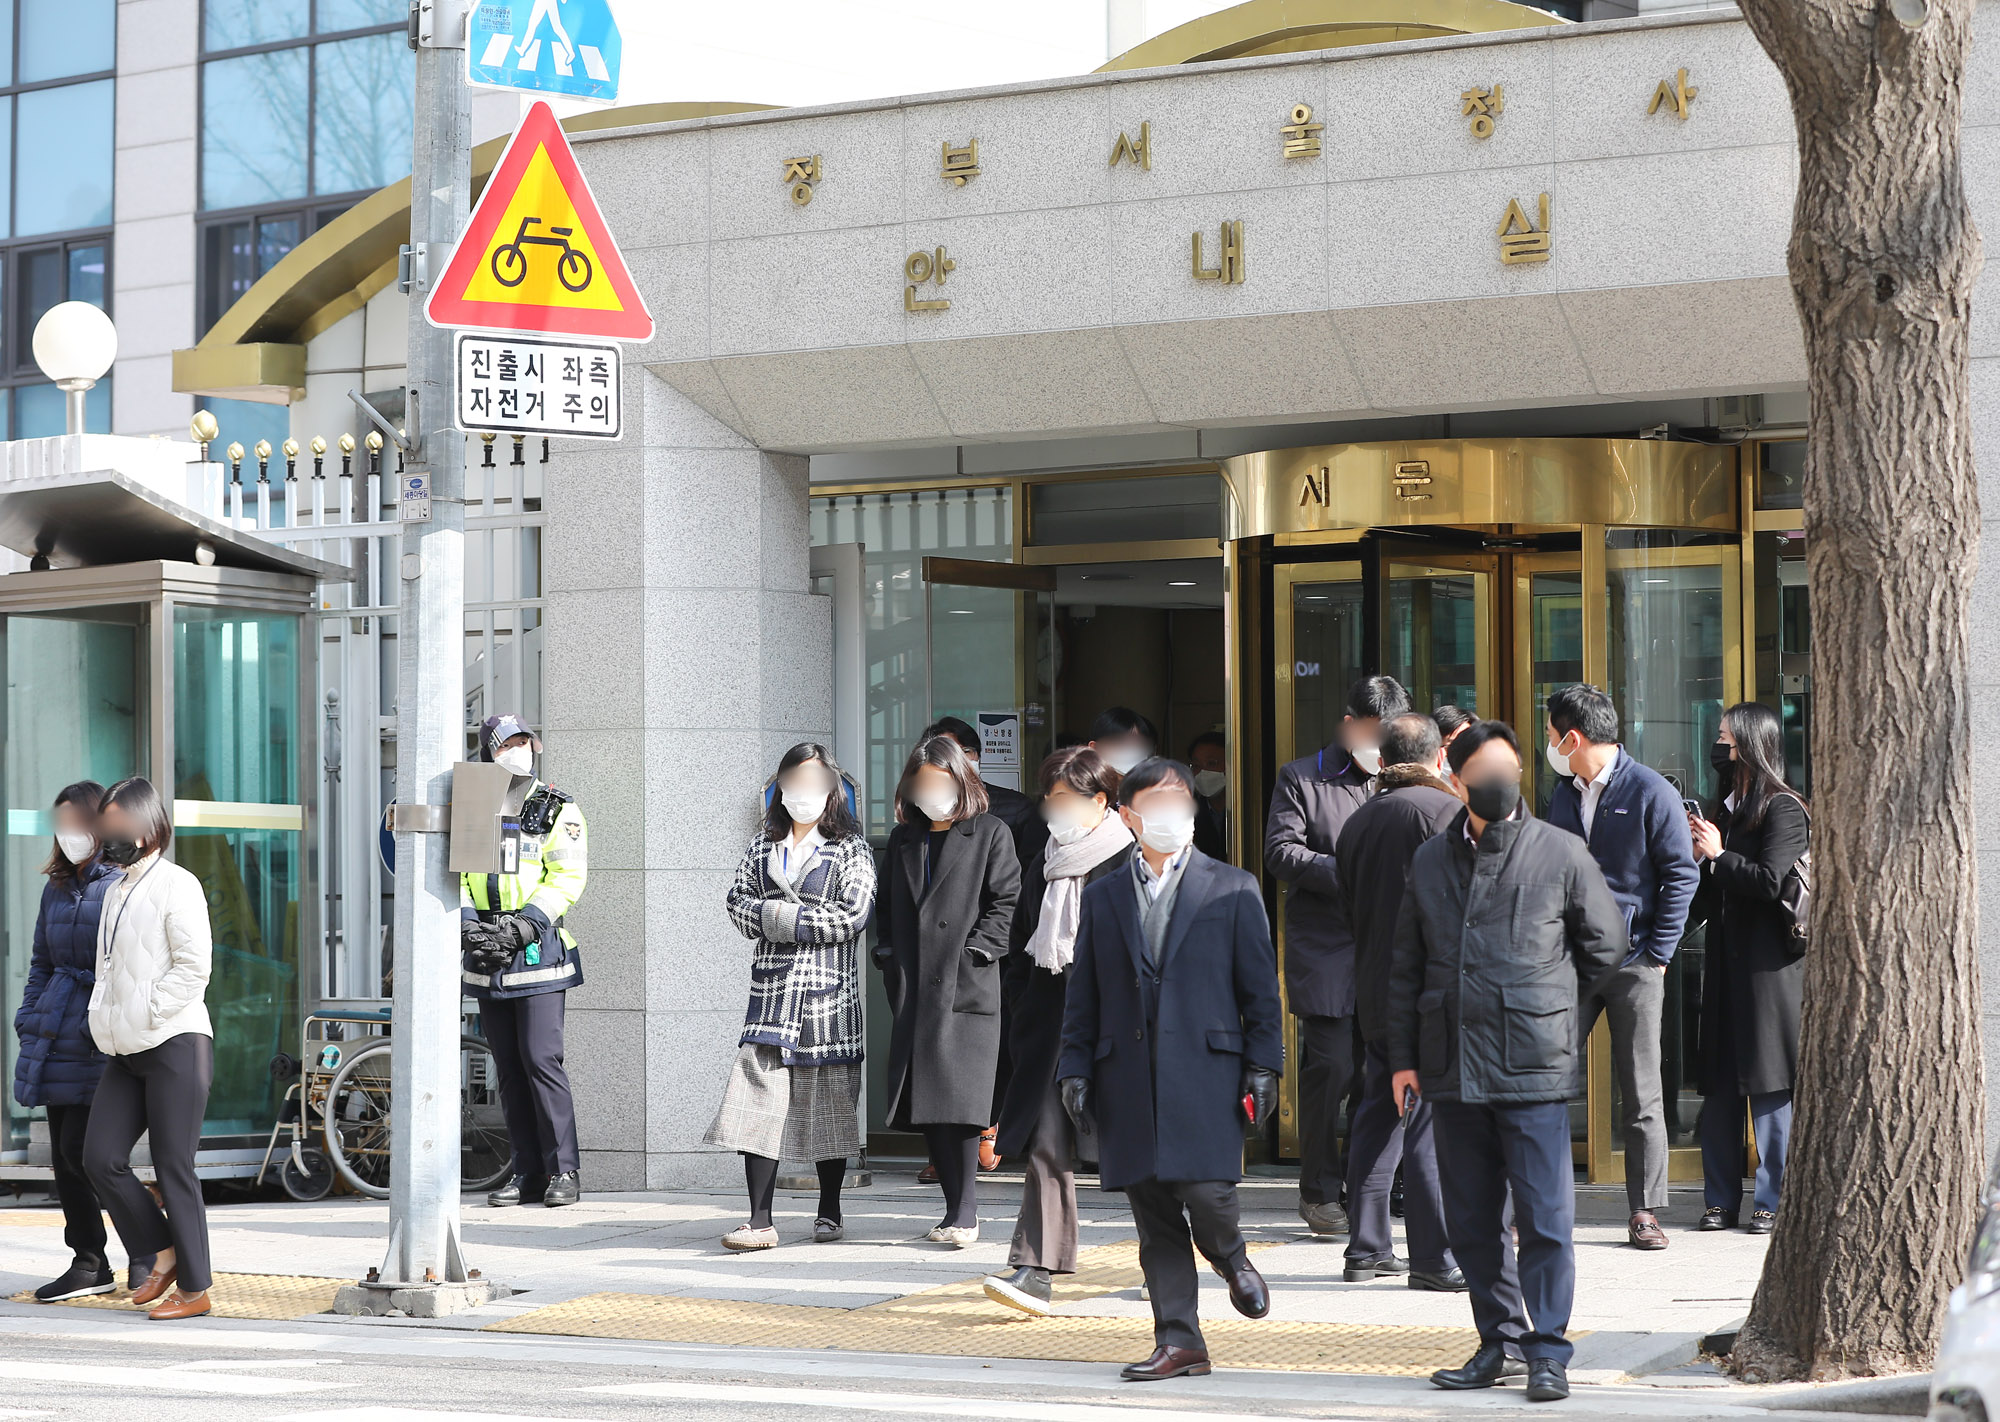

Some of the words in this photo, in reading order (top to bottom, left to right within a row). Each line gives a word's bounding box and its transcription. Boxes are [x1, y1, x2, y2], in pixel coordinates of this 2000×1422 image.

[470, 348, 545, 384] 진출시
[562, 355, 610, 388] 좌측
[470, 387, 545, 421] 자전거
[562, 393, 609, 425] 주의
